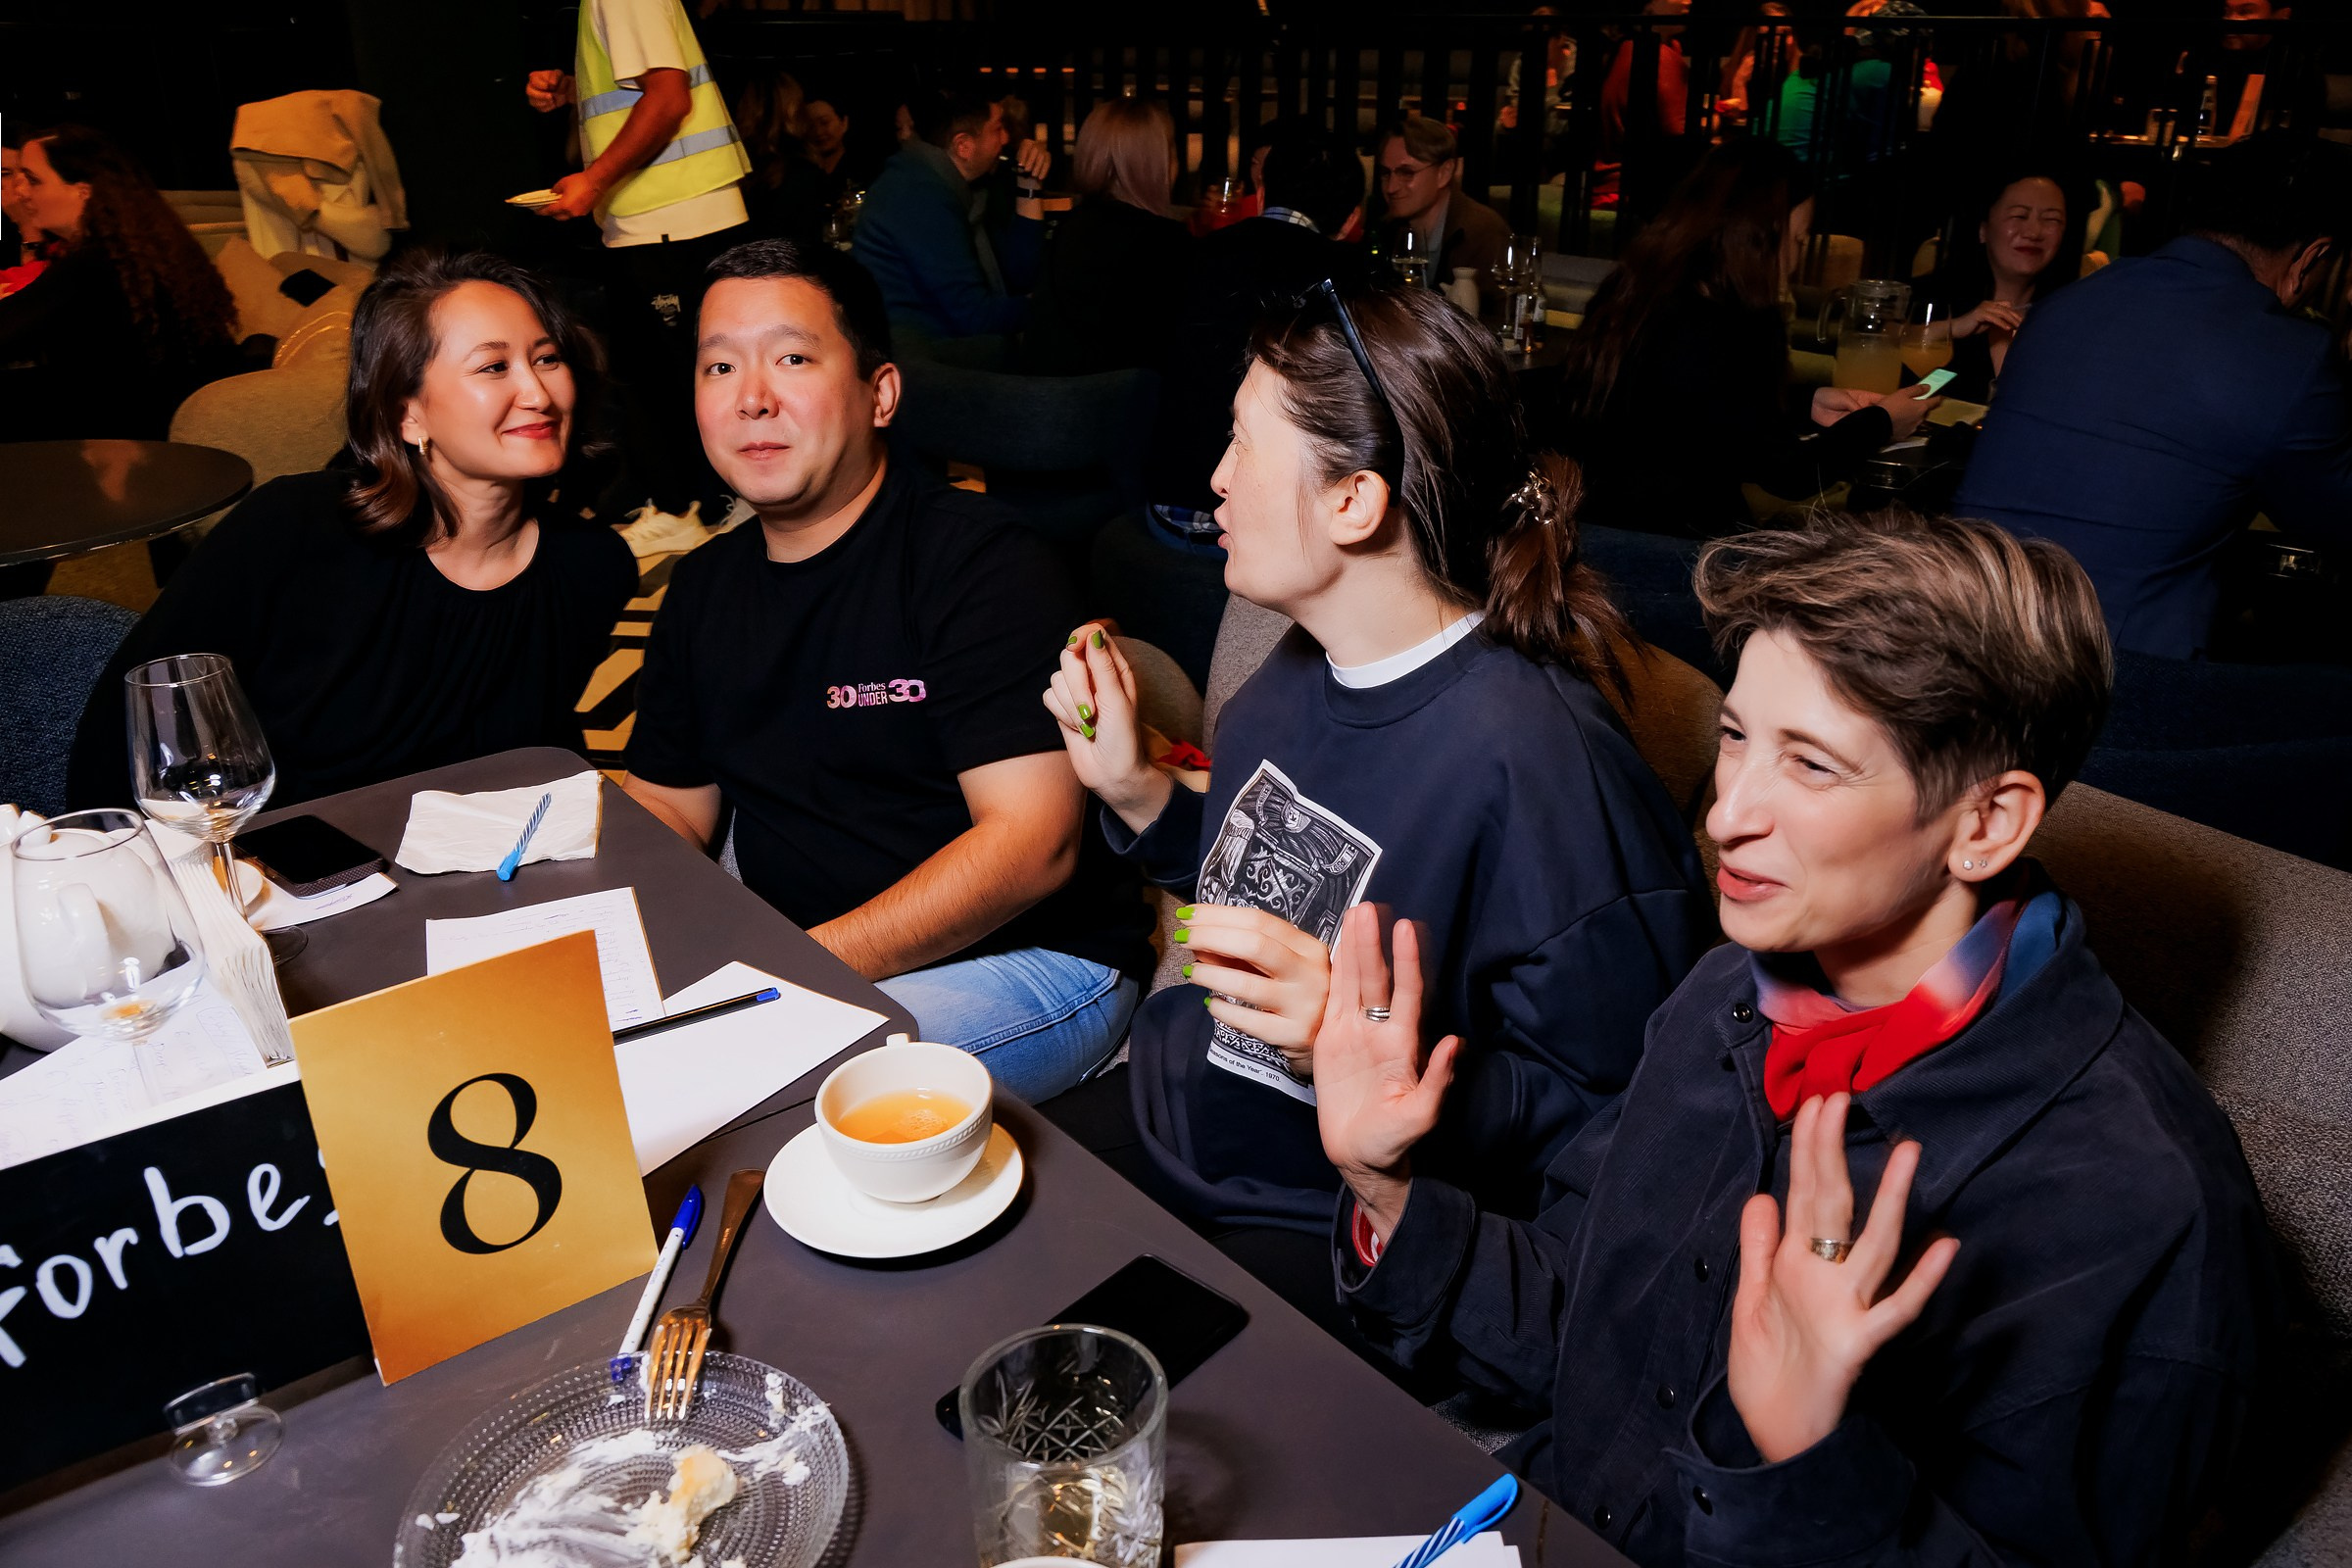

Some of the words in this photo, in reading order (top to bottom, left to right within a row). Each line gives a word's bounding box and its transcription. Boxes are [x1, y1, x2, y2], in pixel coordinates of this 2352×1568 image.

[826, 685, 858, 709] 30
[858, 691, 889, 708] UNDER
[888, 678, 927, 703] 30
[858, 682, 886, 694] Forbes
[1209, 1046, 1228, 1062] easons
[427, 1072, 563, 1254] 8
[0, 1150, 339, 1368] orbe
